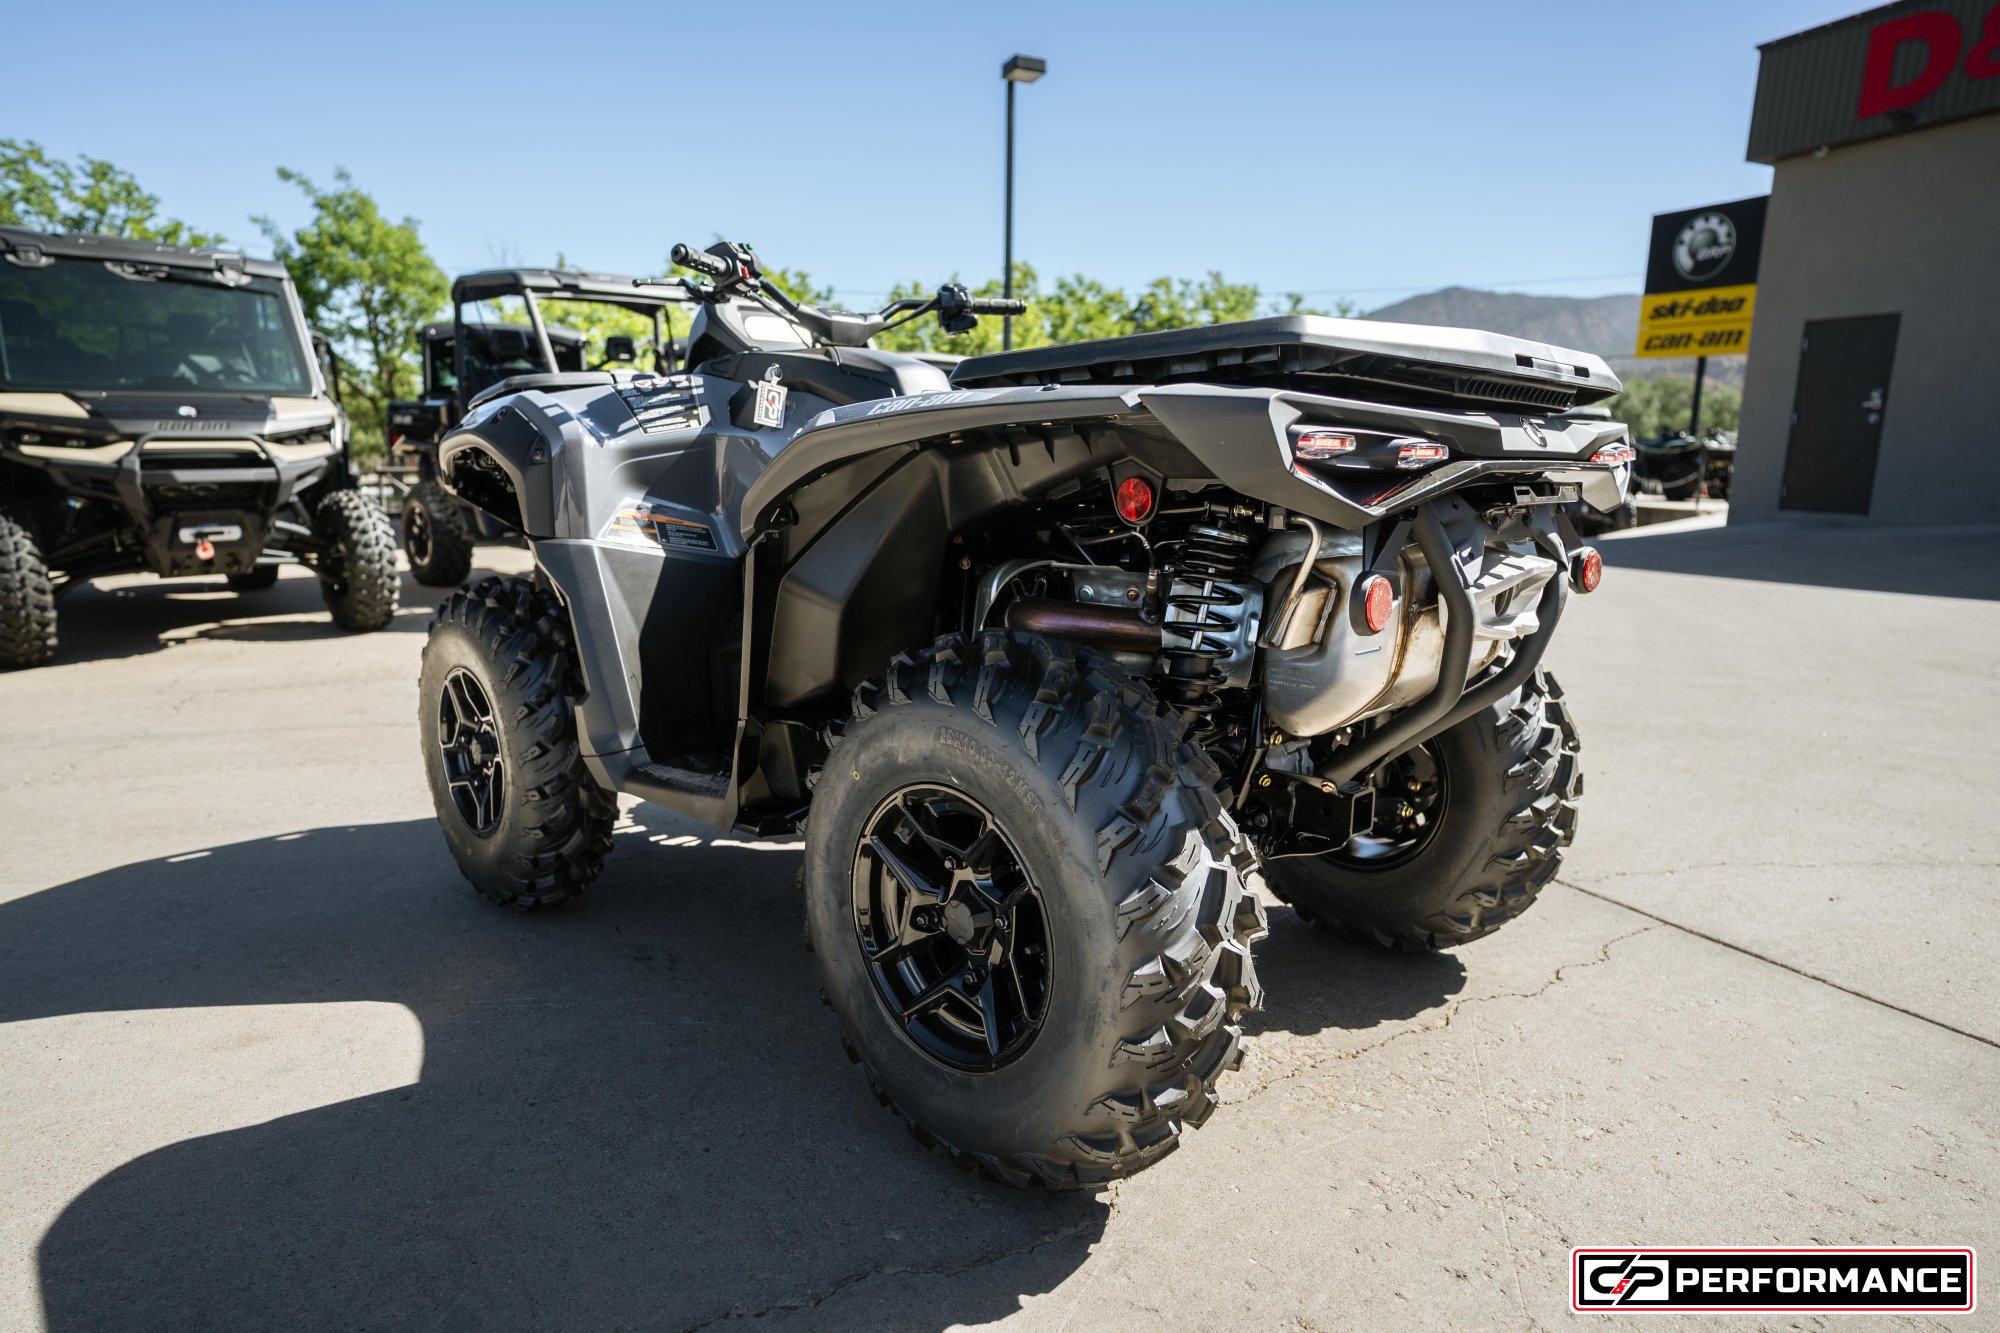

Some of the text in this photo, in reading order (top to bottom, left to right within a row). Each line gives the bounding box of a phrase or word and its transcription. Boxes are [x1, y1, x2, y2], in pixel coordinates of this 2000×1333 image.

[1649, 296, 1747, 320] ski-doo
[1645, 329, 1744, 350] can-am
[866, 392, 974, 416] can-am
